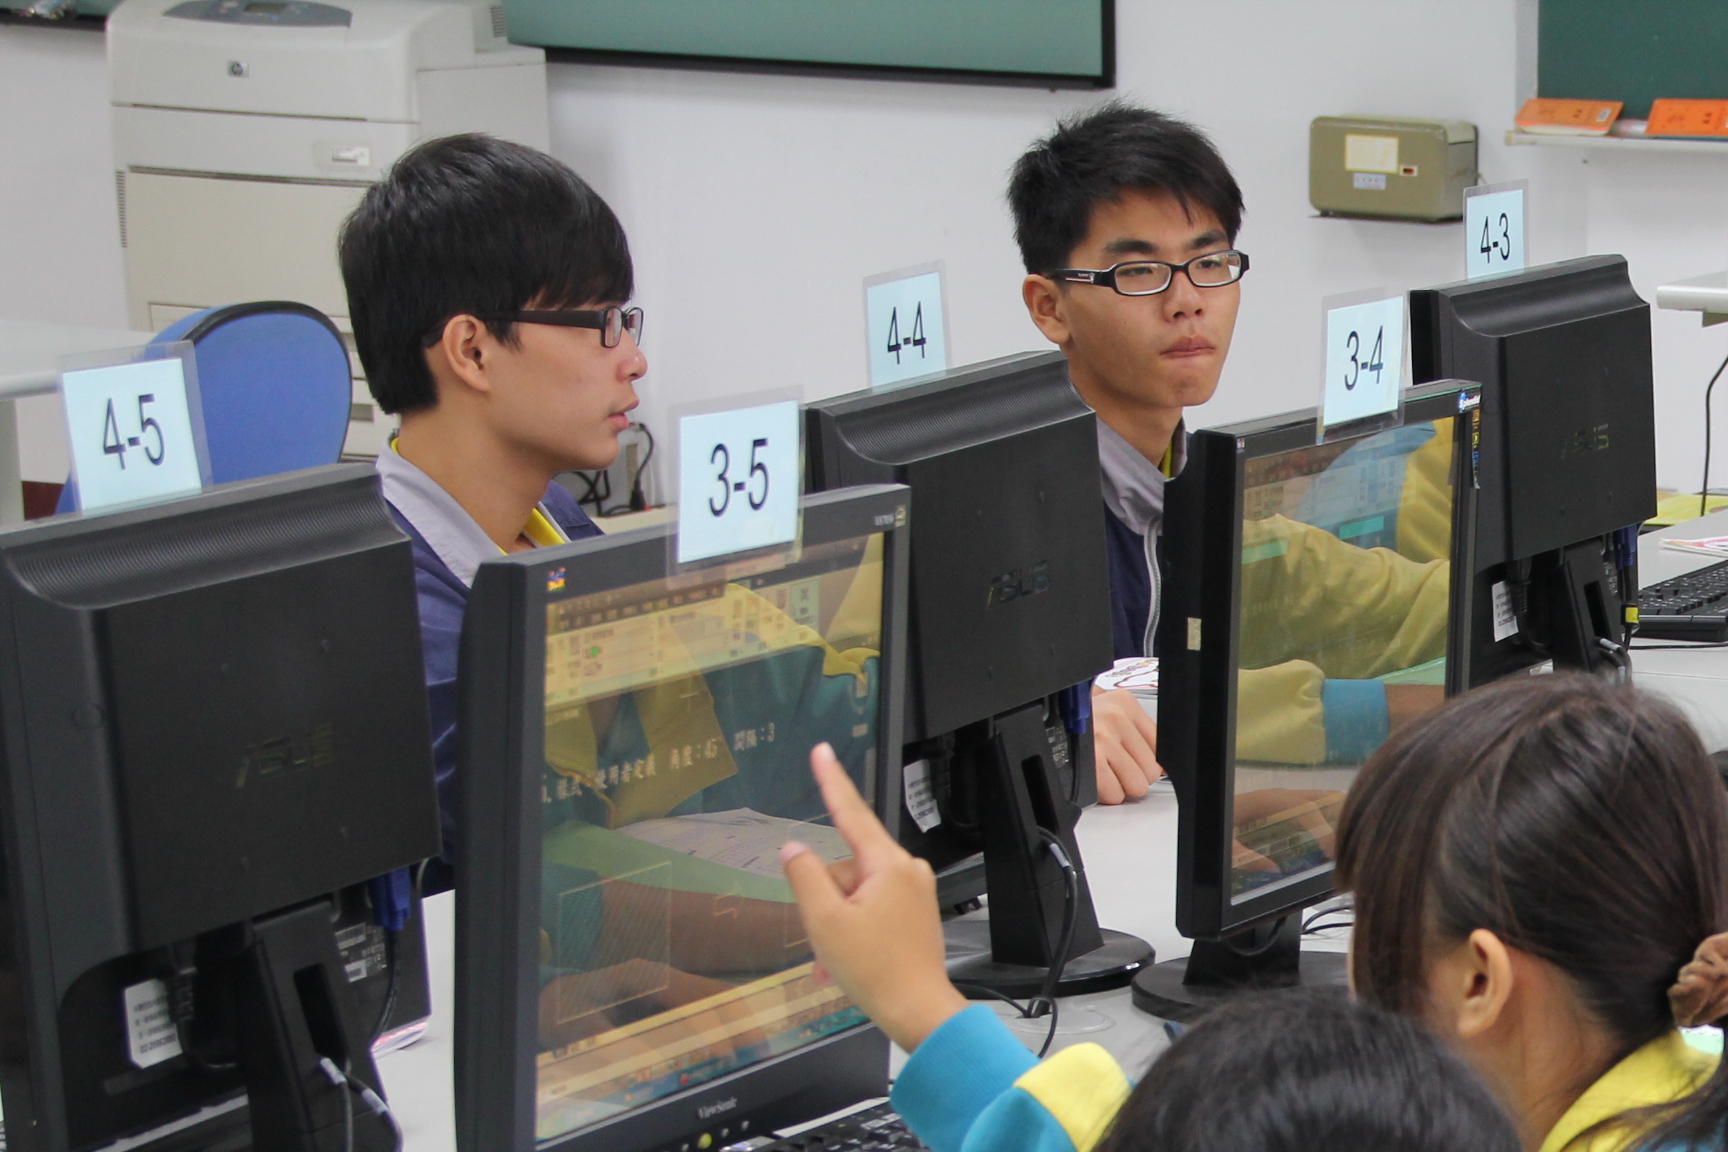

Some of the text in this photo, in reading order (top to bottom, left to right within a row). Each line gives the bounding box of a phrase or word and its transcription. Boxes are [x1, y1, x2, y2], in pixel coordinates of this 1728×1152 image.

[1480, 212, 1511, 264] 4-3
[886, 301, 927, 365] 4-4
[1344, 325, 1384, 391] 3-4
[102, 393, 165, 470] 4-5
[708, 437, 769, 518] 3-5
